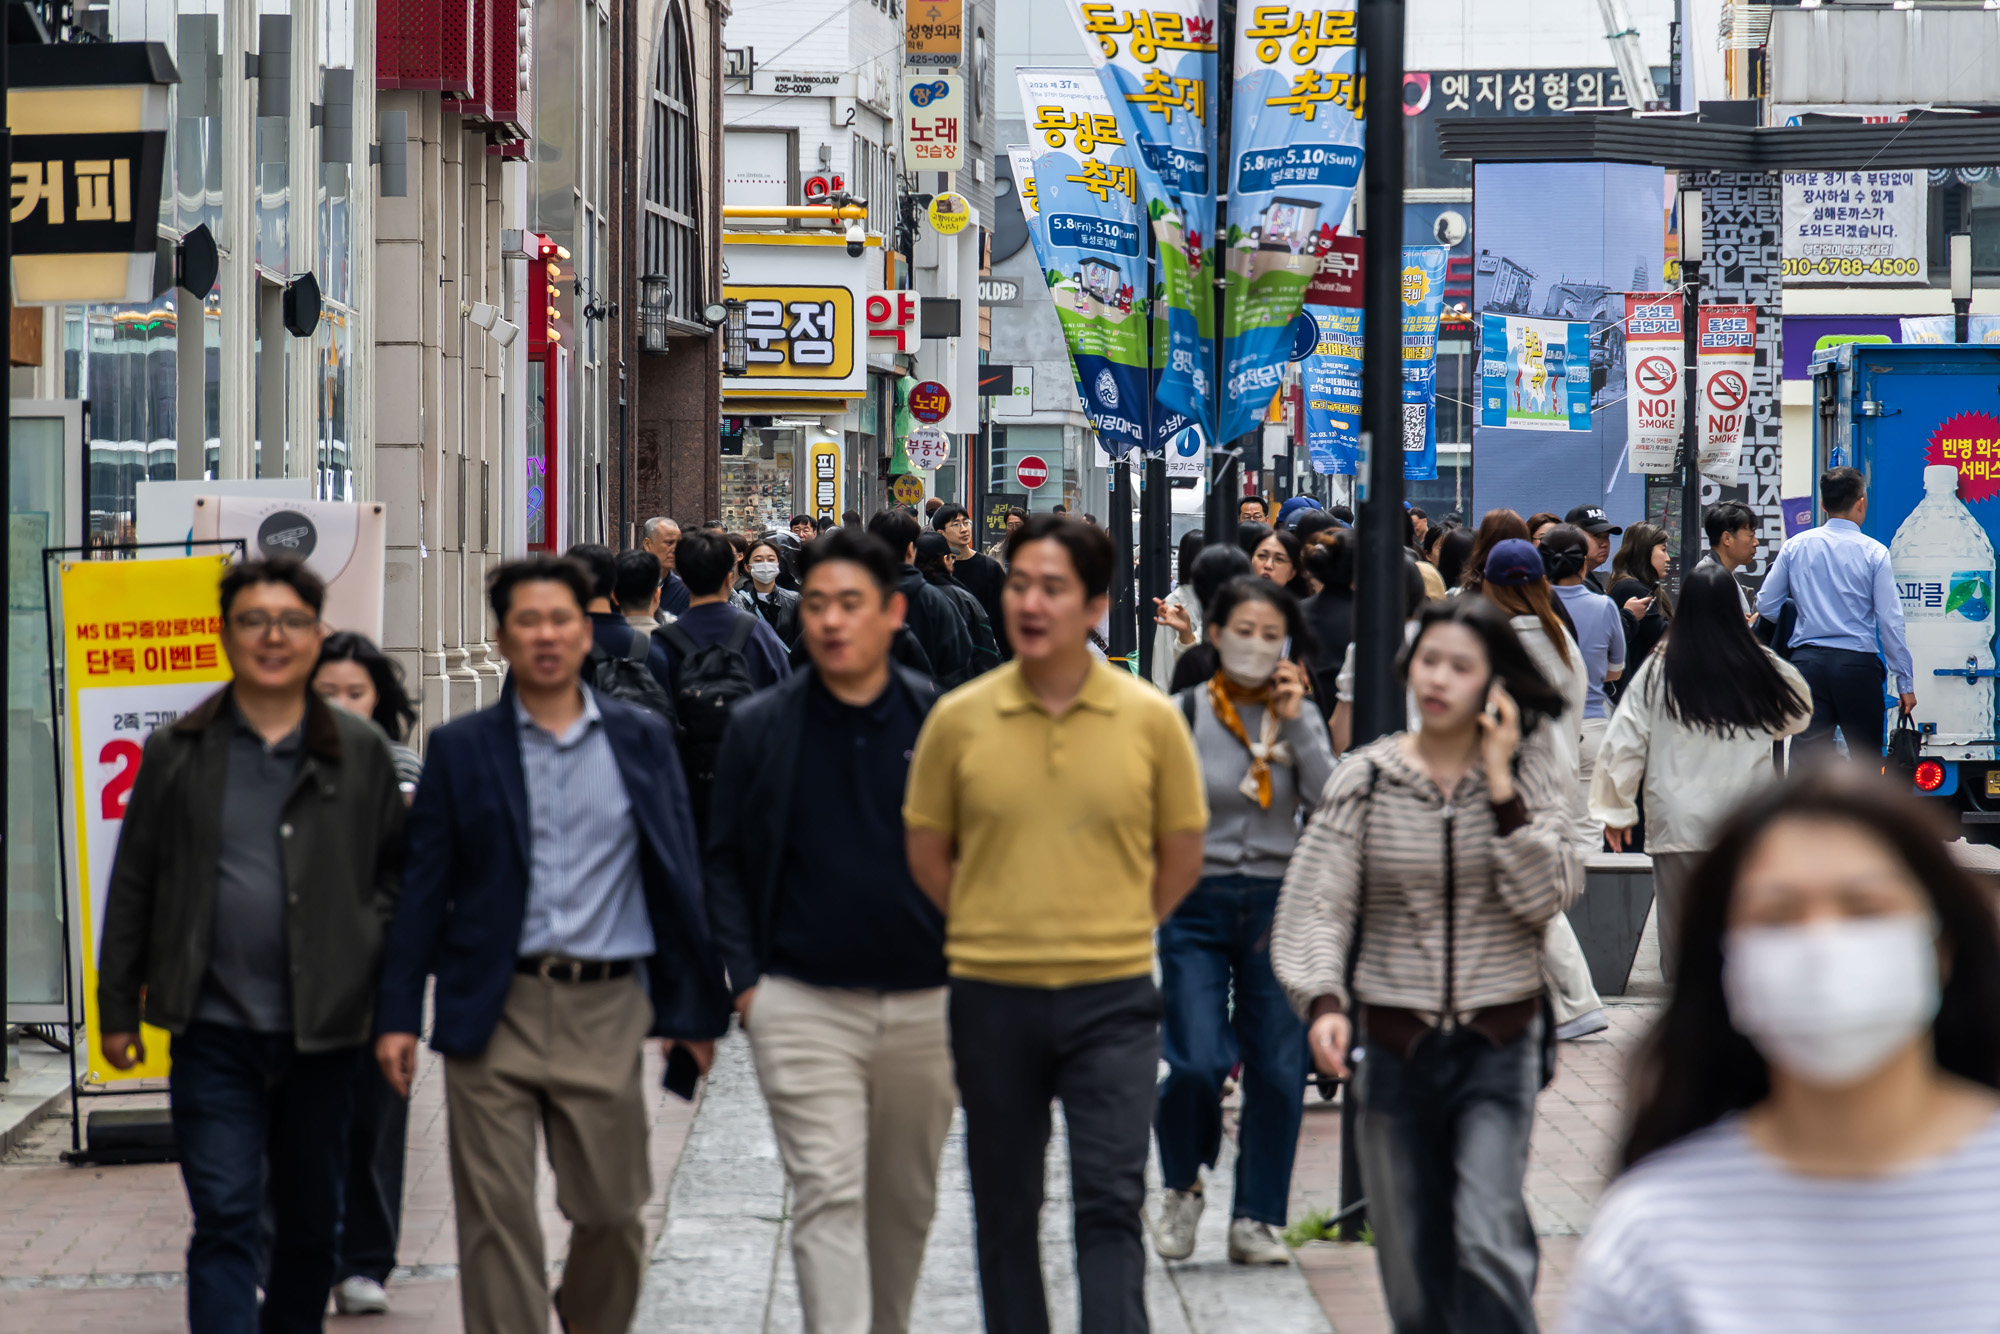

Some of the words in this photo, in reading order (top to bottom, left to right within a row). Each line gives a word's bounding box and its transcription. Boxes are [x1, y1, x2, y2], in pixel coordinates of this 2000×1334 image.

[907, 24, 962, 40] 성형외과
[1245, 6, 1358, 64] 동성로
[907, 40, 923, 50] 의원
[910, 55, 957, 64] 425-0009
[774, 84, 812, 93] 425-0009
[1059, 80, 1072, 89] 37
[1124, 68, 1206, 126] 축제
[910, 117, 957, 143] 노래
[1033, 105, 1127, 154] 동성로
[915, 144, 957, 159] 연습장
[1066, 158, 1137, 205] 축제
[1784, 173, 1819, 186] 어려운
[1823, 172, 1846, 186] 경기
[1851, 172, 1862, 186] 속
[1867, 172, 1913, 186] 부담없이
[10, 158, 131, 224] 커피
[1803, 190, 1850, 203] 장사하실
[1854, 190, 1866, 203] 수
[1871, 190, 1894, 203] 있게
[1813, 207, 1884, 220] 심해돈까스가
[1799, 224, 1898, 238] 도와드리겠습니다.
[1803, 244, 1841, 256] 부담없이
[1842, 244, 1893, 256] 전화주세요!
[1319, 251, 1359, 278] 특구
[1781, 257, 1919, 276] 010-6788-4500
[979, 281, 1017, 300] OLDER
[1634, 305, 1675, 319] 동성로
[866, 293, 915, 351] 약
[1628, 319, 1681, 334] 금연거리
[1708, 318, 1748, 332] 동성로
[723, 300, 836, 366] 문점
[1702, 333, 1753, 347] 금연거리
[913, 394, 946, 413] 노래
[1638, 398, 1676, 418] NO!
[1638, 419, 1675, 429] SMOKE
[1708, 414, 1742, 433] NO!
[1708, 434, 1739, 444] SMOKE
[907, 439, 947, 457] 부동산
[1942, 438, 1972, 459] 빈병
[920, 458, 932, 468] 3F
[1166, 462, 1205, 473] 국가스공
[815, 453, 836, 521] 필름
[77, 623, 99, 640] MS
[86, 647, 136, 675] 단독
[144, 643, 219, 672] 이벤트
[113, 712, 140, 731] 2족
